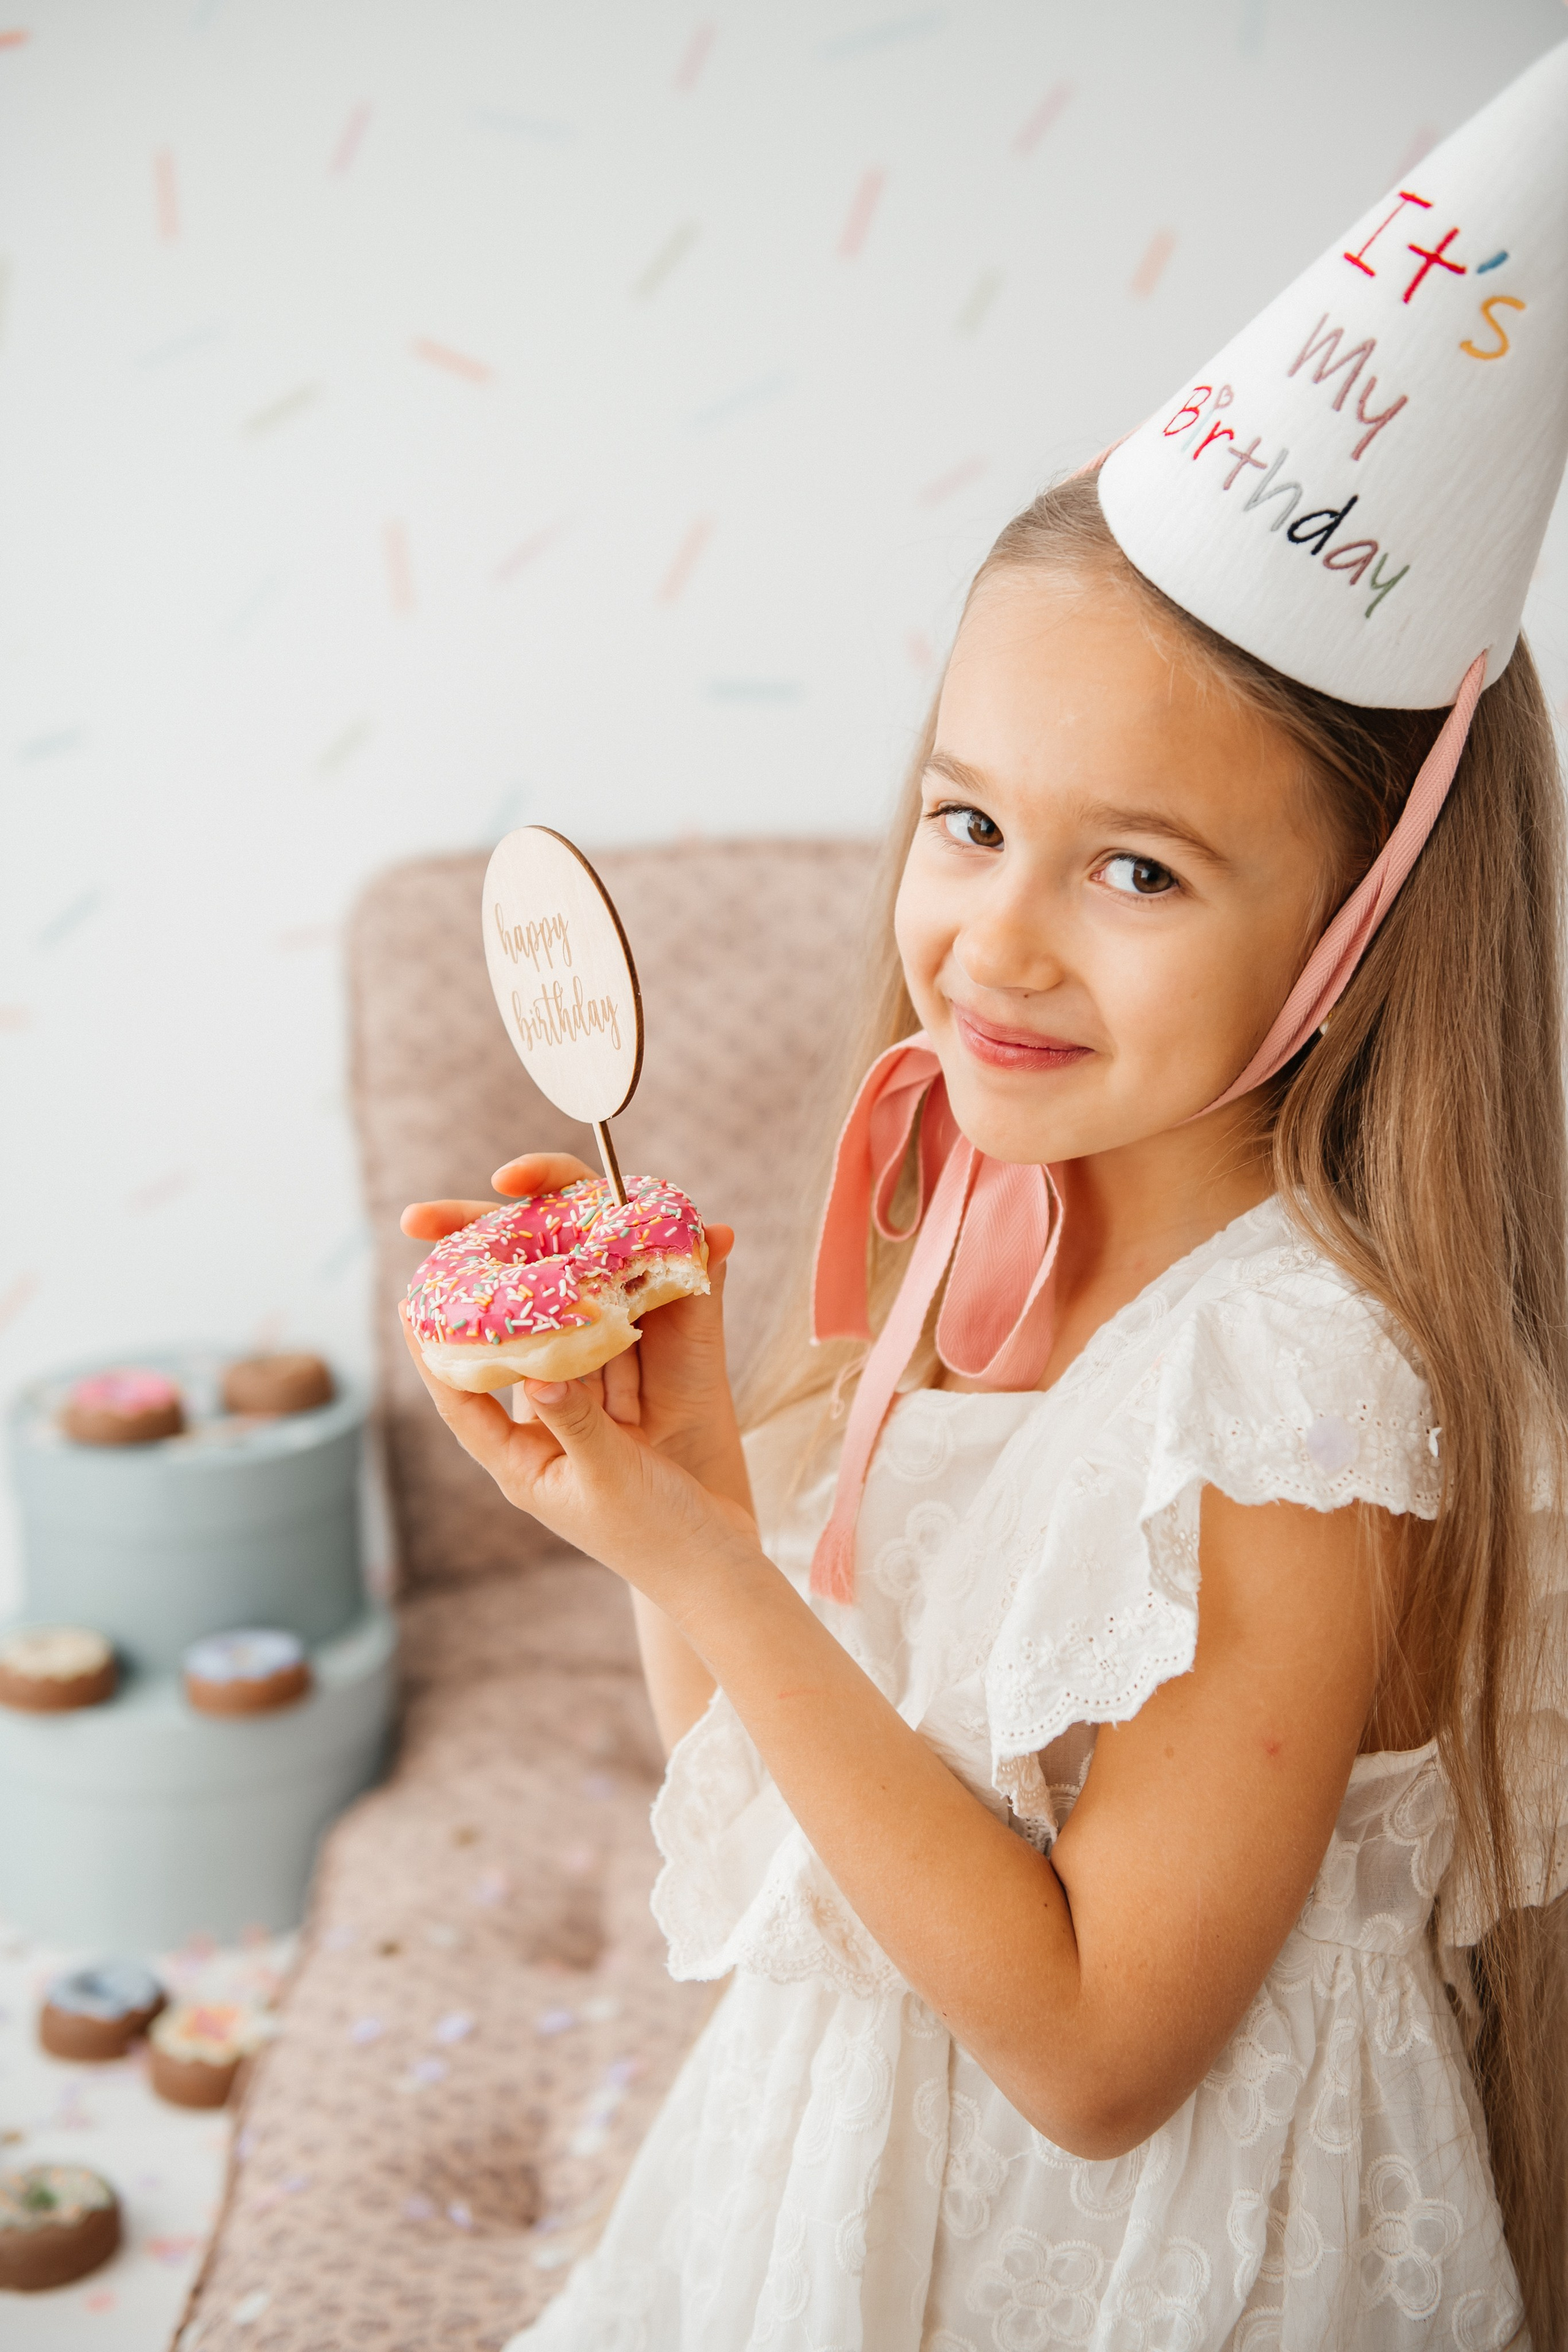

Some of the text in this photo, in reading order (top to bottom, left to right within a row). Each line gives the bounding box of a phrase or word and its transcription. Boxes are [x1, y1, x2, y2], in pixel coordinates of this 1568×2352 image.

[1343, 190, 1526, 360] It's
[1287, 312, 1409, 462] My
[1163, 384, 1411, 619] Birthday
[494, 902, 573, 973] happy
[511, 975, 621, 1052] birthday
